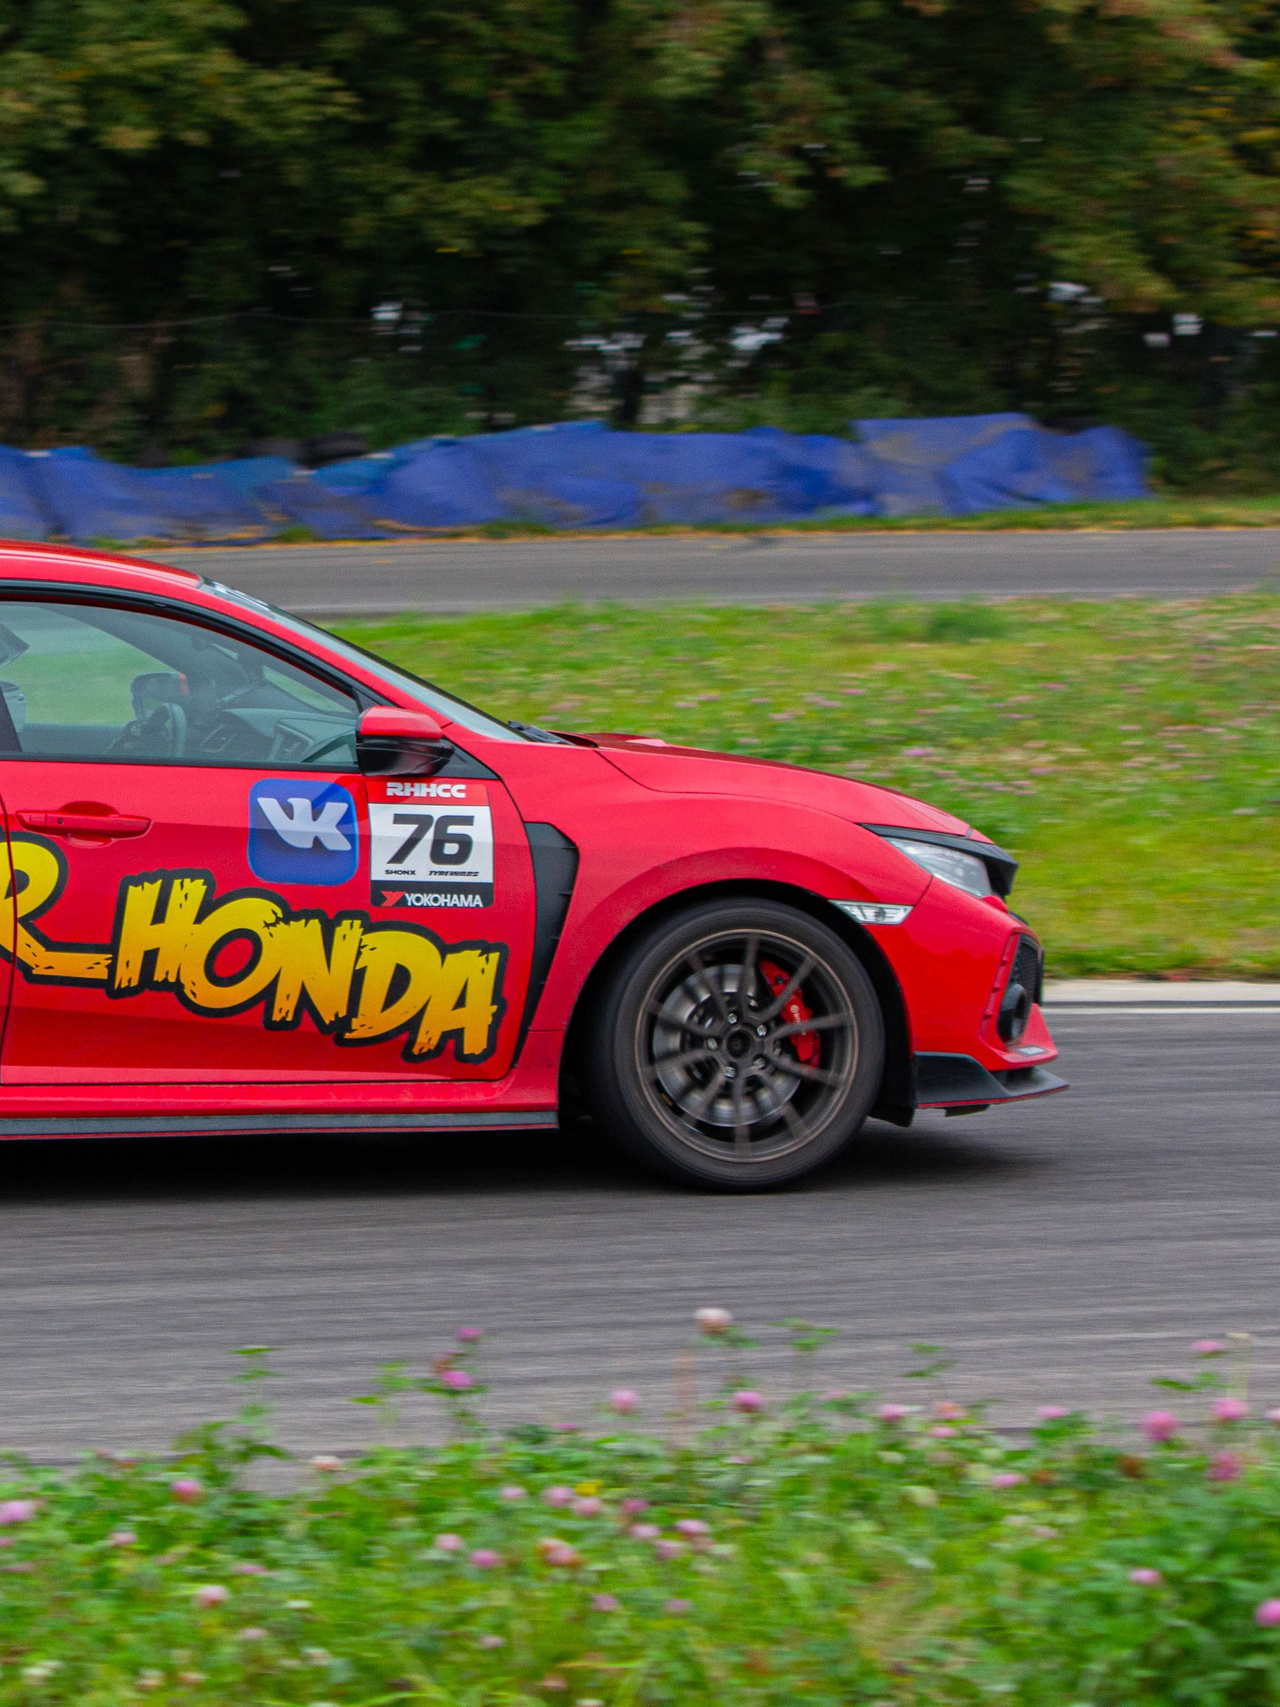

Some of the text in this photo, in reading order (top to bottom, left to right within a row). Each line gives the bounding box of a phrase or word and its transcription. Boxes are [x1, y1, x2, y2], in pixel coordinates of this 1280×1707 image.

[386, 782, 467, 798] RHHCC
[256, 797, 353, 851] VK
[386, 813, 476, 867] 76
[405, 893, 484, 908] YOKOHAMA
